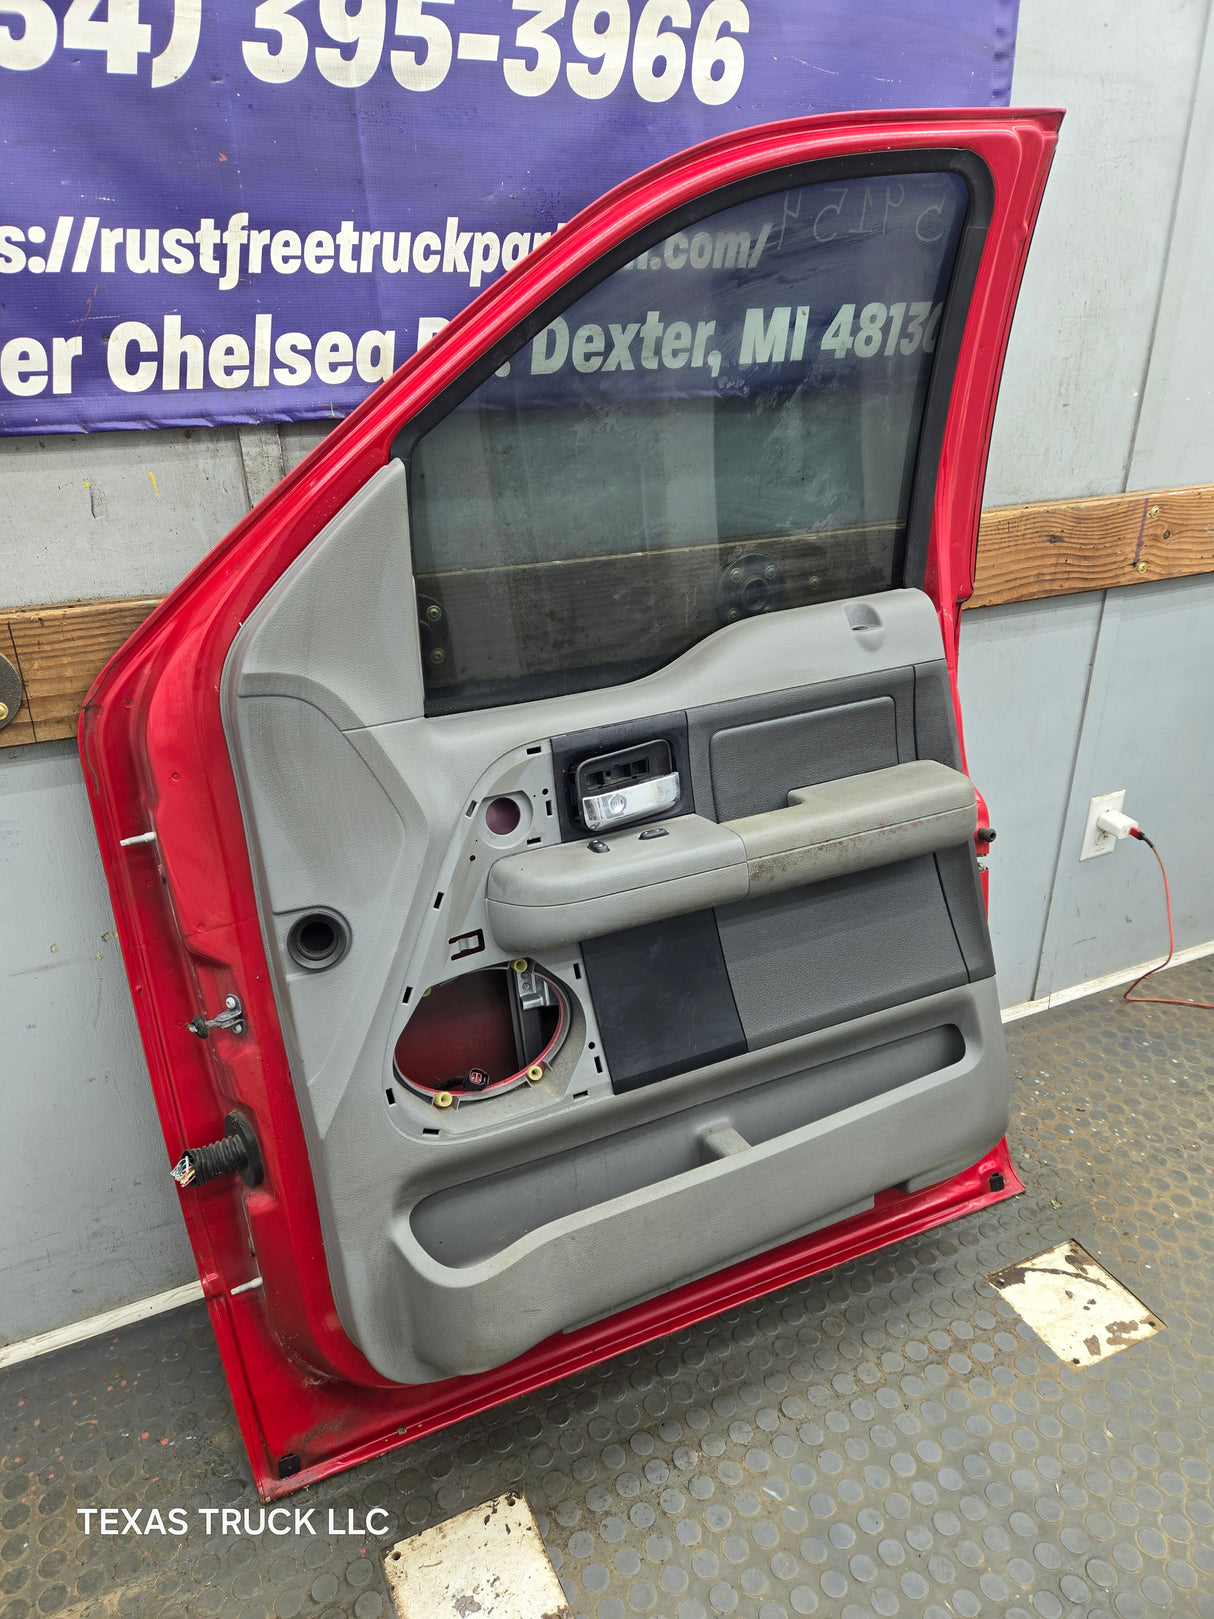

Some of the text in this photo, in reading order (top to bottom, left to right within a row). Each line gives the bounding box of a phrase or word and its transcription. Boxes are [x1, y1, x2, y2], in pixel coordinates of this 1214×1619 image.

[242, 0, 750, 105] 395-3966
[107, 314, 396, 392] Chelsea
[531, 311, 722, 377] Dexter,
[739, 306, 810, 364] MI
